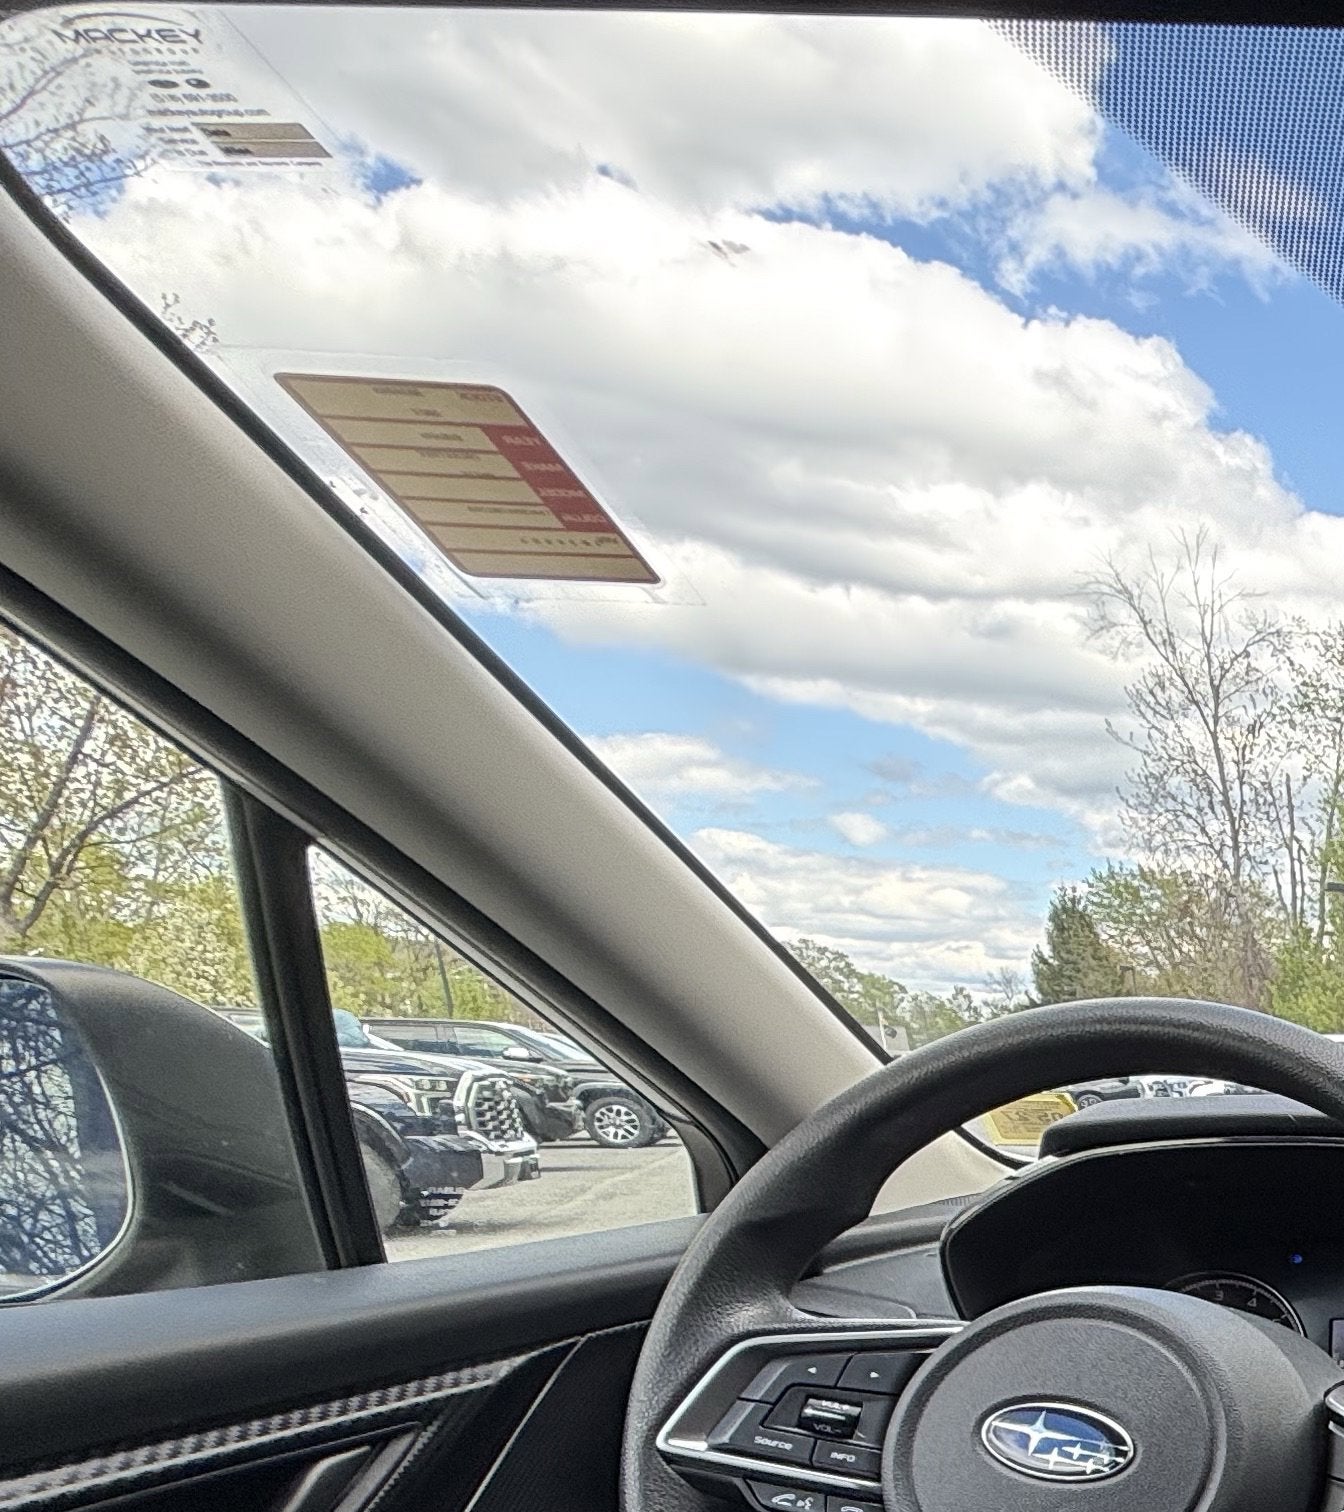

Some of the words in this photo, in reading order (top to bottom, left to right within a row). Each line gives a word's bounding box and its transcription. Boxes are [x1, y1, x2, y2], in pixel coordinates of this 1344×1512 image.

[51, 27, 204, 44] MACKEY
[1215, 1290, 1224, 1301] 3
[1247, 1297, 1257, 1307] 4
